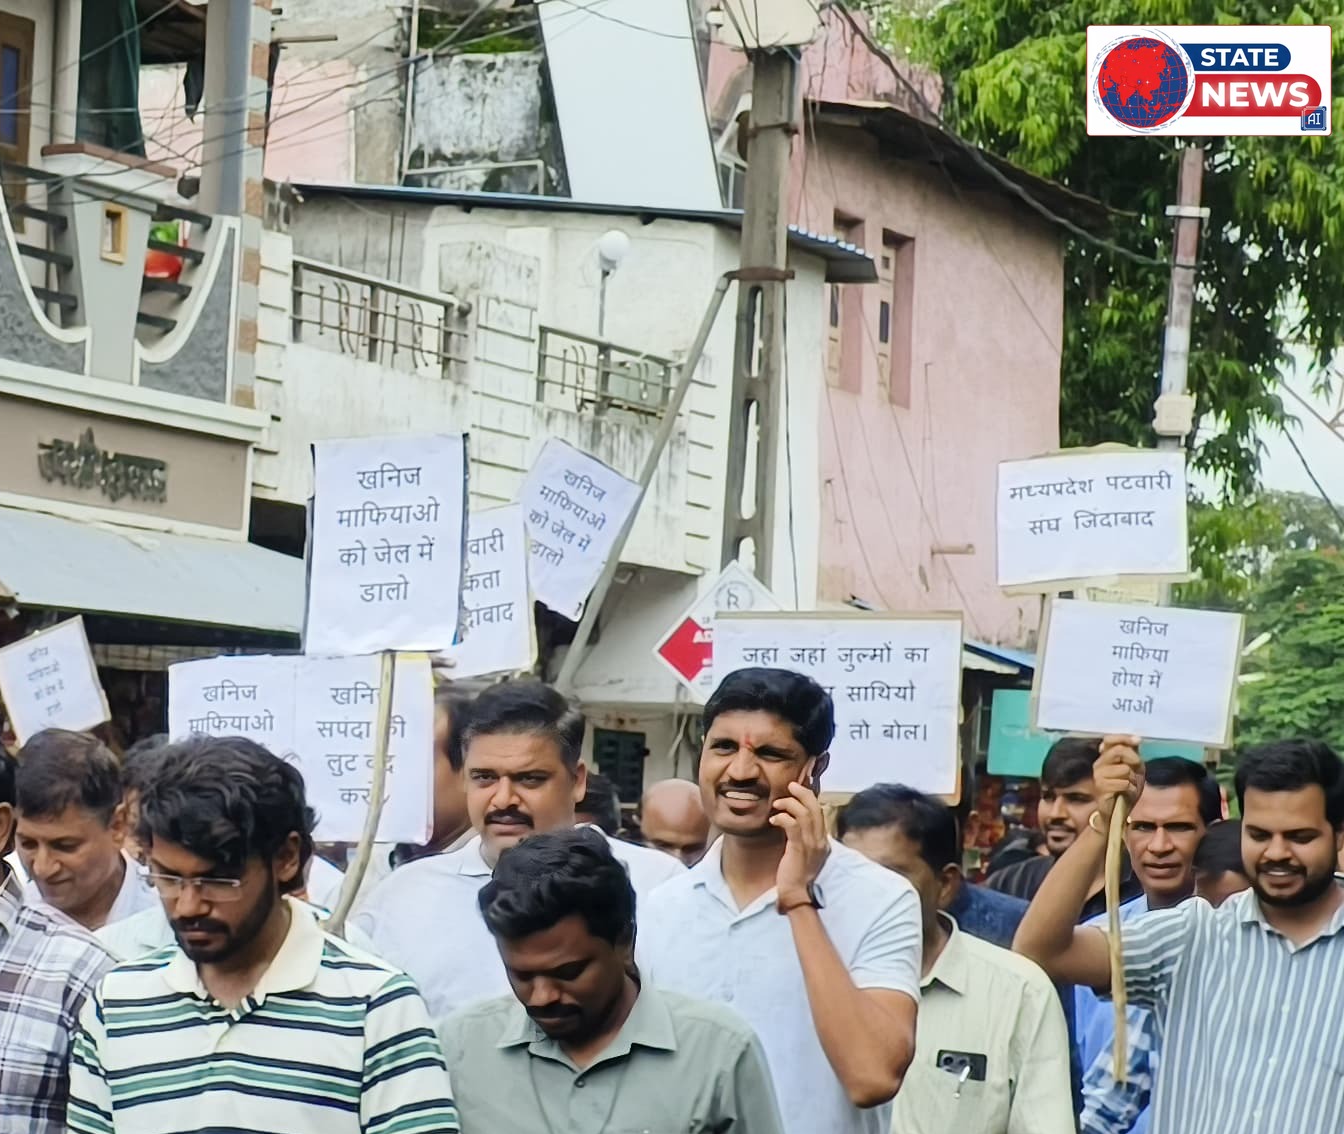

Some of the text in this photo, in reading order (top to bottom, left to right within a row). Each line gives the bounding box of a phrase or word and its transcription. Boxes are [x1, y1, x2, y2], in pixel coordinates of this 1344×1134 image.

[357, 463, 422, 489] खनिज
[563, 469, 607, 501] खनिज
[1009, 470, 1172, 501] मध्यप्रदेश पटवारी
[337, 498, 440, 527] माफियाओ
[539, 484, 606, 531] माफियाओ
[467, 528, 504, 555] वारी
[529, 508, 593, 552] को जेल में
[339, 535, 435, 567] को जेल में
[360, 575, 409, 602] डालो
[463, 569, 500, 592] कता
[1119, 616, 1169, 637] खनिज
[904, 647, 930, 664] का
[1112, 643, 1169, 663] माफिया
[1112, 667, 1163, 688] होश में
[203, 680, 258, 702] खनिज
[329, 681, 381, 705] खनि
[846, 680, 916, 703] साथियो
[188, 709, 275, 736] माफियाओ
[850, 719, 927, 741] तो बोल।
[325, 754, 359, 776] लुट
[339, 781, 372, 804] कर
